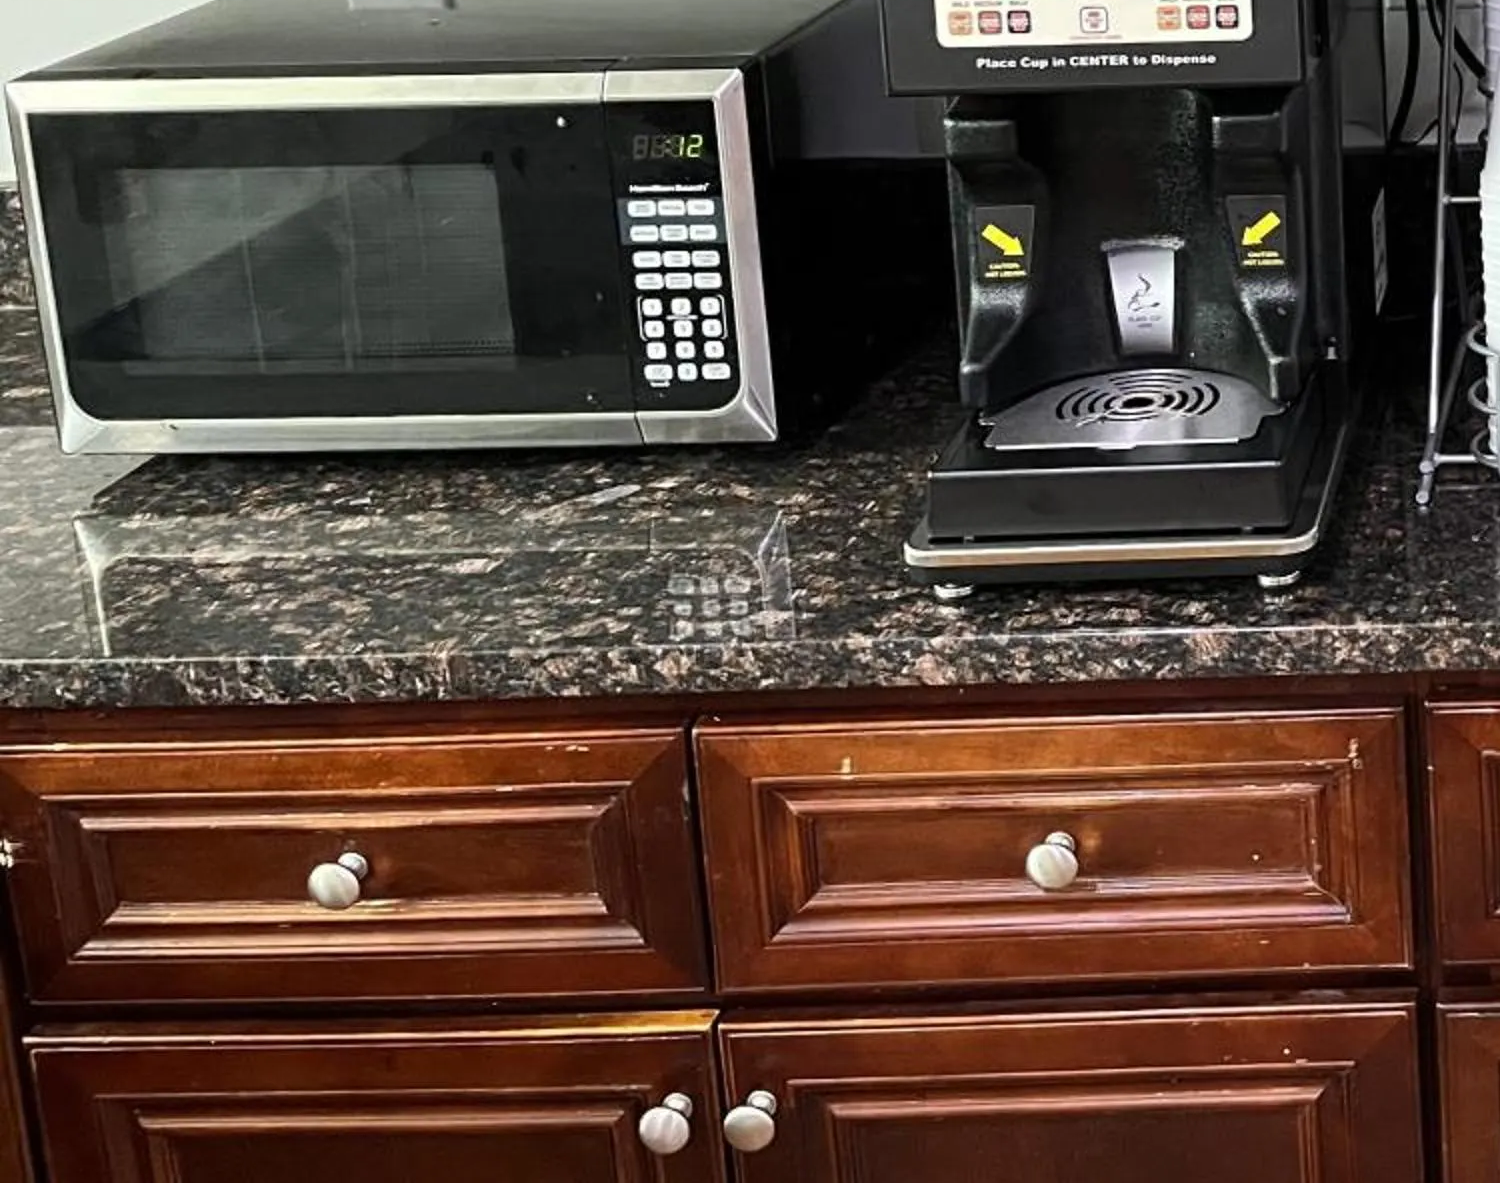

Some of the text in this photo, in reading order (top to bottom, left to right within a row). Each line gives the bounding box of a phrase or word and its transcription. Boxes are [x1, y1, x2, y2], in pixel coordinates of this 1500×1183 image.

[976, 54, 1217, 69] Place Cup in CENTER to Dispense
